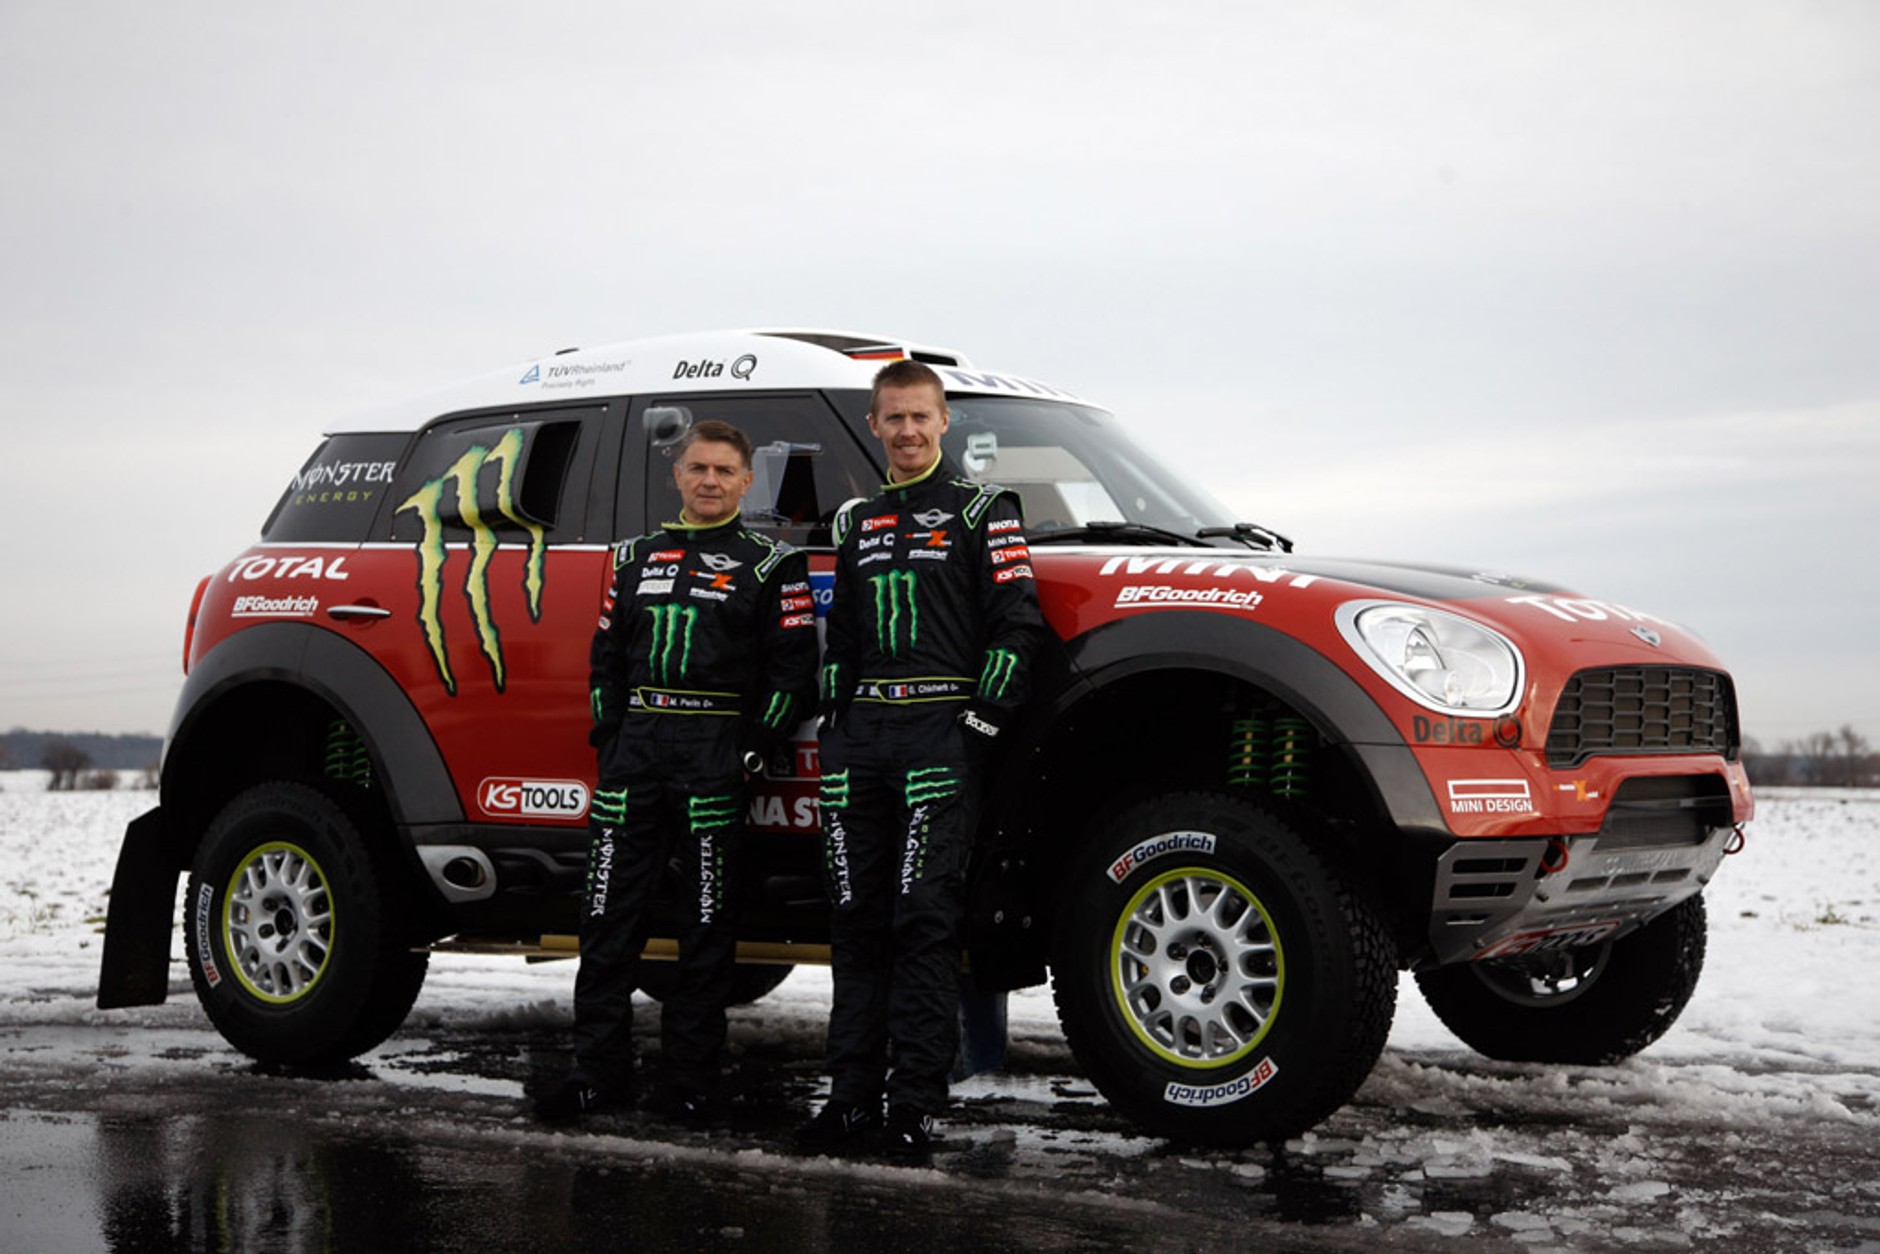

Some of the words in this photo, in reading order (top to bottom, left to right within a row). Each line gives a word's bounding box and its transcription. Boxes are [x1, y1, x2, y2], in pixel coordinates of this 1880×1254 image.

[673, 360, 725, 380] Delta
[292, 460, 396, 490] MONSTER
[296, 491, 373, 505] ENERGY
[227, 554, 350, 583] TOTAL
[231, 595, 319, 618] BFGoodrich
[1115, 586, 1263, 609] BFGoodrich
[1413, 716, 1483, 743] Delta
[485, 784, 521, 808] KS
[521, 788, 579, 809] TOOLS
[1451, 800, 1483, 813] MINI
[1487, 800, 1533, 811] DESIGN
[590, 827, 615, 917] MONSTER
[1111, 834, 1213, 882] BFGoodrich
[699, 834, 715, 923] MONSTER
[199, 886, 221, 983] BFGoodrich
[1167, 1061, 1274, 1104] BFGoodrich
